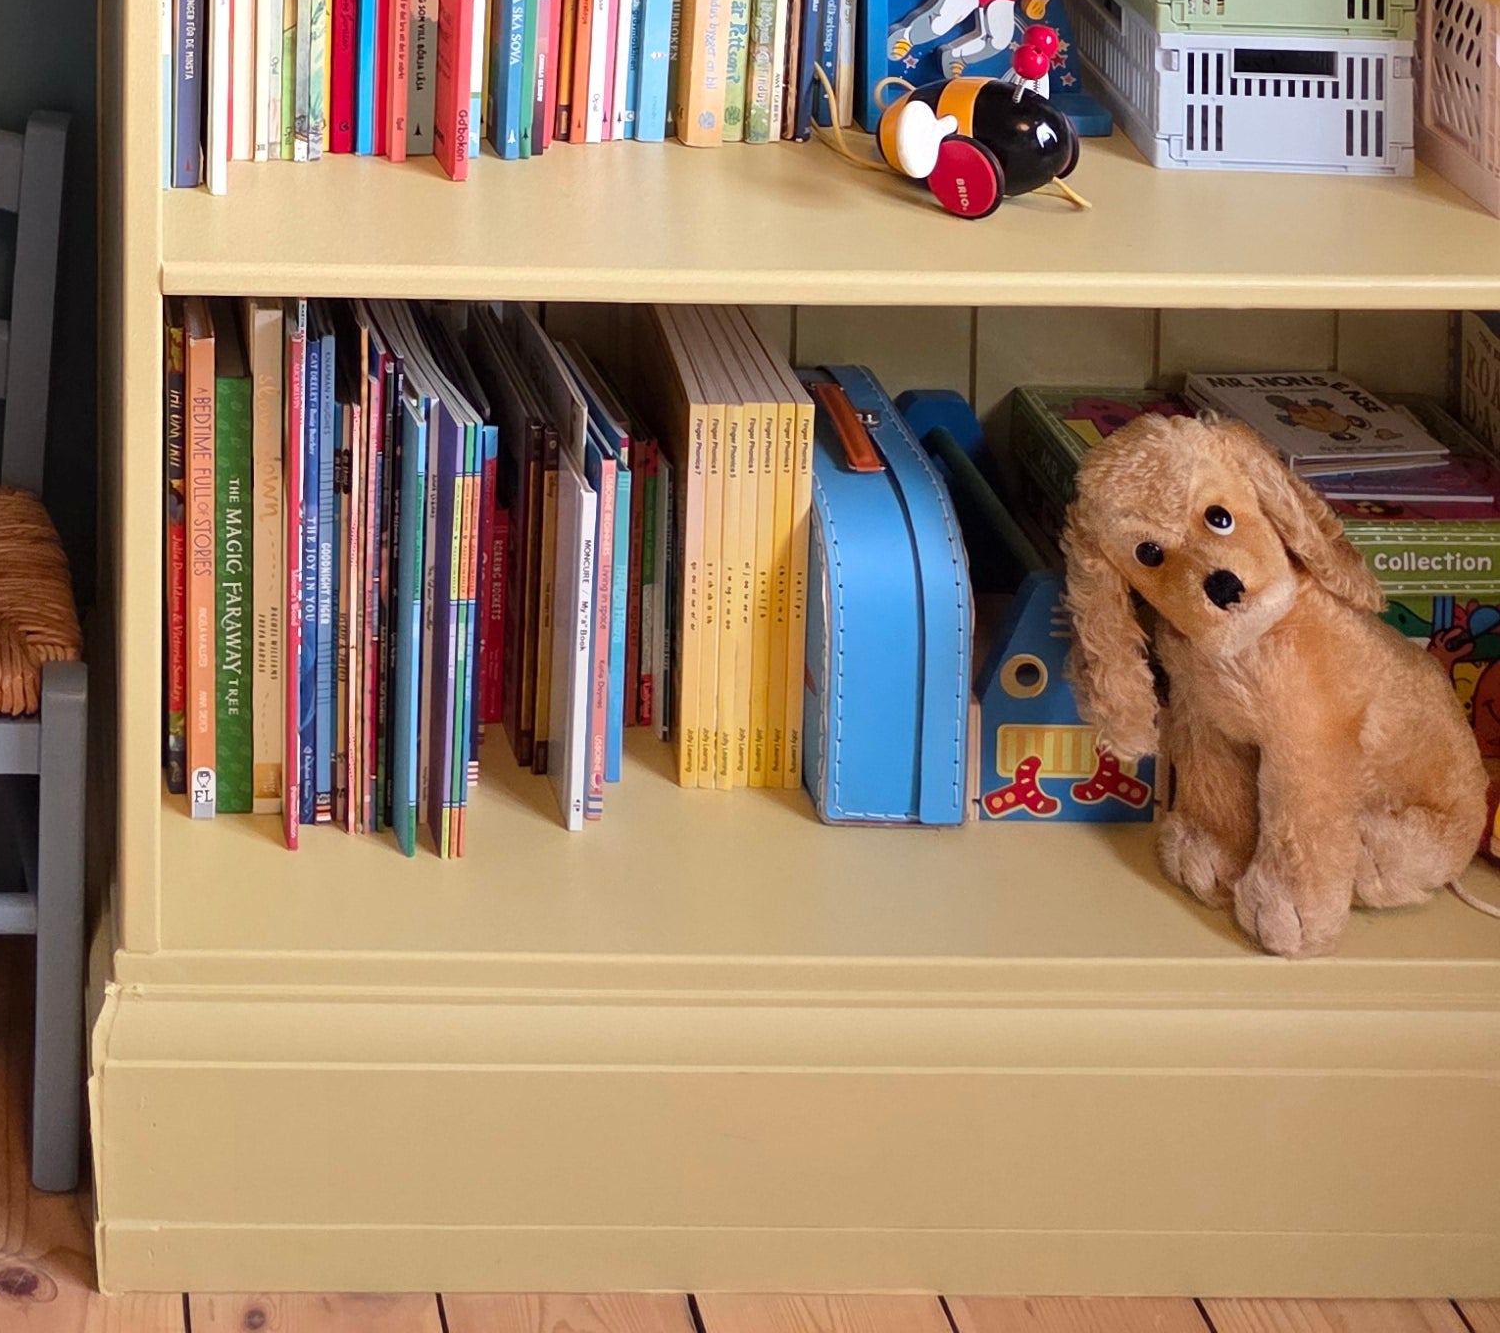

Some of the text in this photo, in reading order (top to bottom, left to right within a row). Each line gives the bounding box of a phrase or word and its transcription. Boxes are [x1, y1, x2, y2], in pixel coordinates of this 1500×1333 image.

[417, 5, 427, 22] SOM
[511, 5, 523, 31] SKA
[731, 0, 748, 19] är
[185, 38, 195, 49] DE
[417, 23, 426, 41] VILL
[704, 23, 722, 58] bygger
[415, 43, 427, 70] BÖRJA
[509, 33, 522, 66] SOVA
[726, 20, 749, 84] Pettson?
[184, 51, 194, 80] MINSTA
[271, 56, 280, 75] Opal
[706, 60, 716, 72] en
[415, 71, 426, 91] LÄSA
[705, 76, 718, 90] bil
[591, 93, 601, 112] Opal
[956, 178, 970, 208] BRIO
[257, 373, 278, 435] slow
[1206, 375, 1387, 415] MR. NONSENSE
[694, 418, 703, 469] Finger Phonics
[711, 418, 719, 440] Finger
[747, 417, 756, 469] Finger Phonics
[764, 417, 773, 468] Finger Phonics
[783, 417, 792, 468] Finger Phonics
[729, 422, 738, 473] Finger Phonics
[800, 418, 809, 470] Finger Phonics
[192, 397, 212, 576] BEDTIME FULL OF STORIES
[305, 352, 318, 622] CAT DEELEY Butcher THE JOY IN YOU
[320, 351, 332, 624] KNAPMAN HUGHES GOODNIGHT TIGER
[1373, 551, 1492, 572] Collection
[491, 539, 503, 621] ROARING ROCKETS
[600, 564, 610, 591] Living
[171, 534, 183, 661] Julia Donaldson Victoria
[221, 478, 243, 715] THE MAGIC FARAWAY TREE
[578, 539, 592, 652] MONCURE My Book
[601, 594, 610, 603] in
[290, 603, 299, 626] Wood
[598, 605, 608, 630] space
[269, 606, 278, 681] RACHEL WILLIAMS
[597, 659, 605, 678] Katie
[596, 681, 605, 709] Daynes
[194, 790, 213, 804] FL
